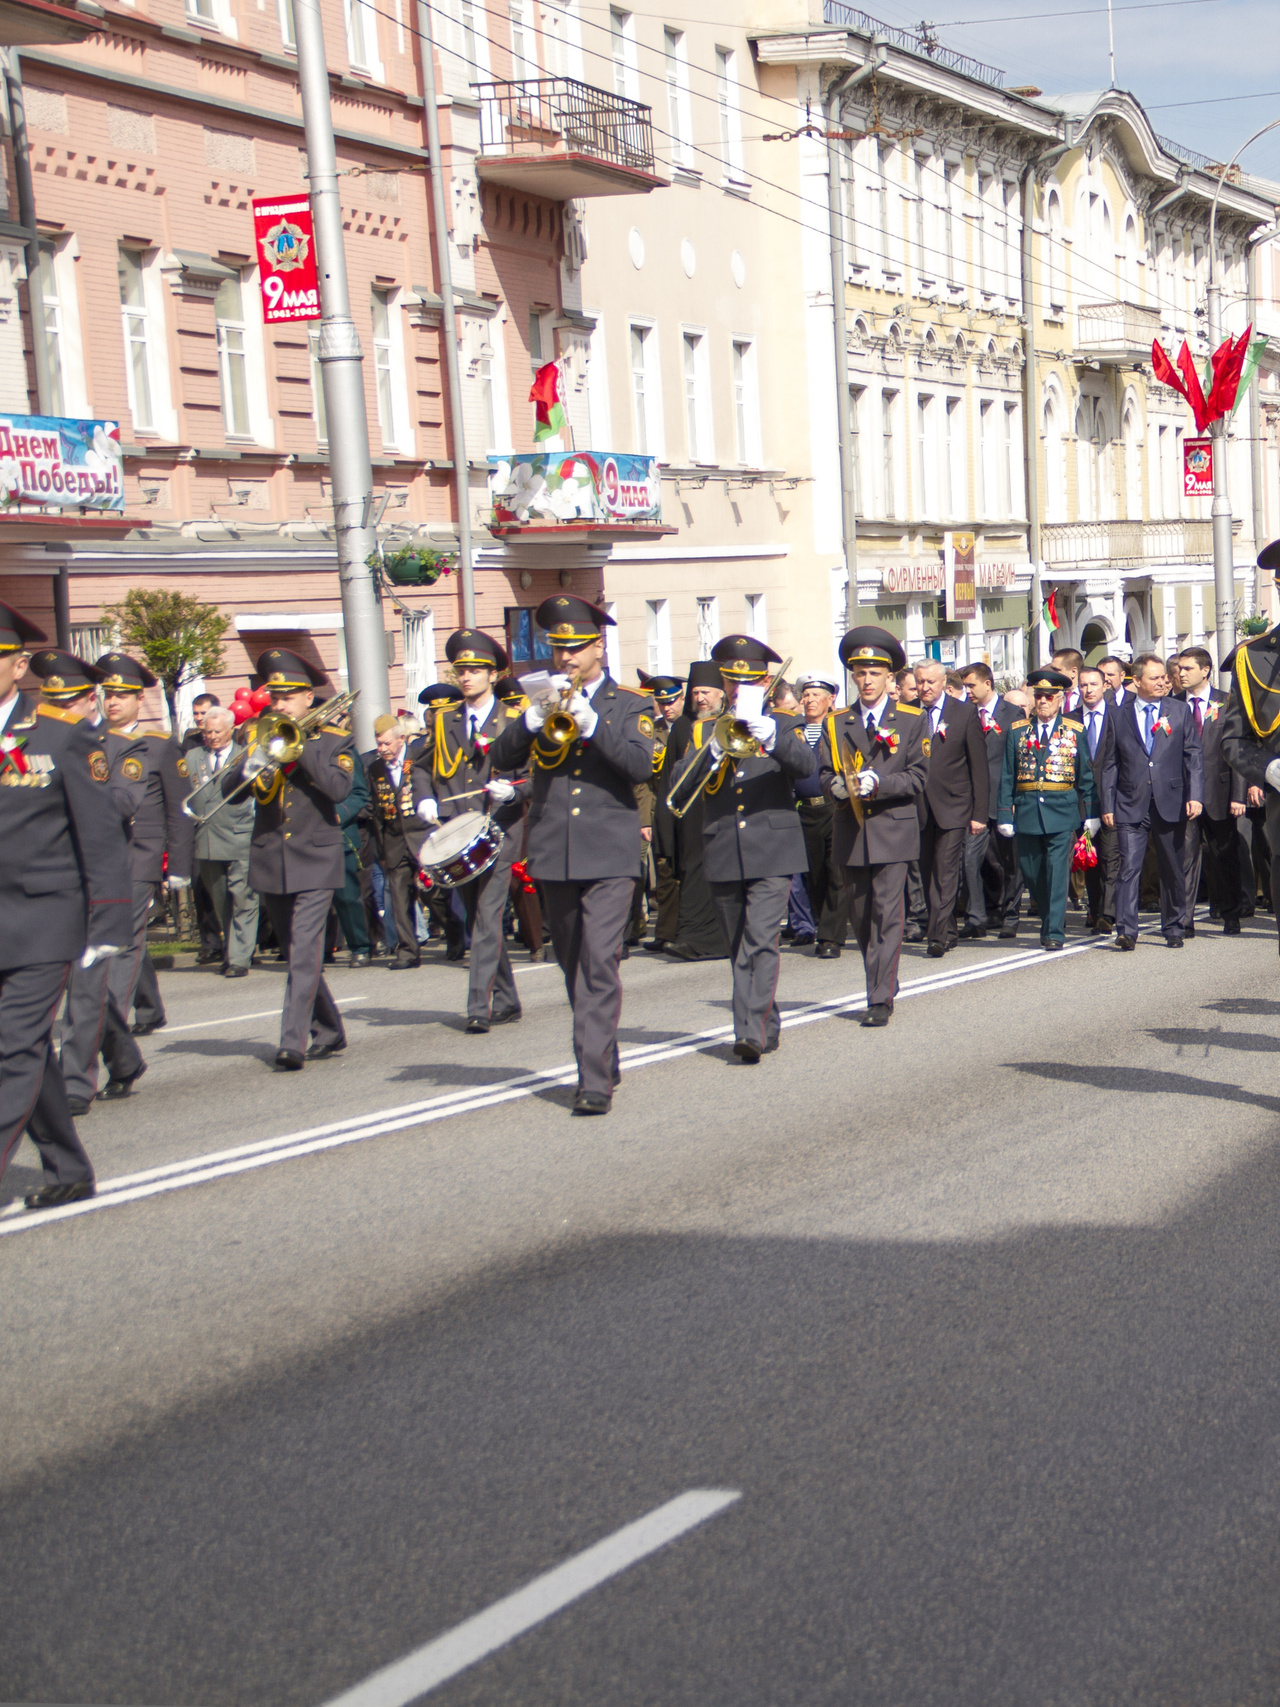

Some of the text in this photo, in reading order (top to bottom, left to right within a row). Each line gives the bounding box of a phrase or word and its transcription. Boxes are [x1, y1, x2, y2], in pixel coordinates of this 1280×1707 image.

[255, 207, 260, 217] С
[264, 276, 318, 309] 9 МАЯ
[0, 426, 60, 461] Днем
[20, 460, 119, 497] Победы!
[605, 462, 619, 506] 9
[1185, 474, 1196, 490] 9
[887, 562, 1016, 592] ФИРМЕННЫЙ МАГАЗИН
